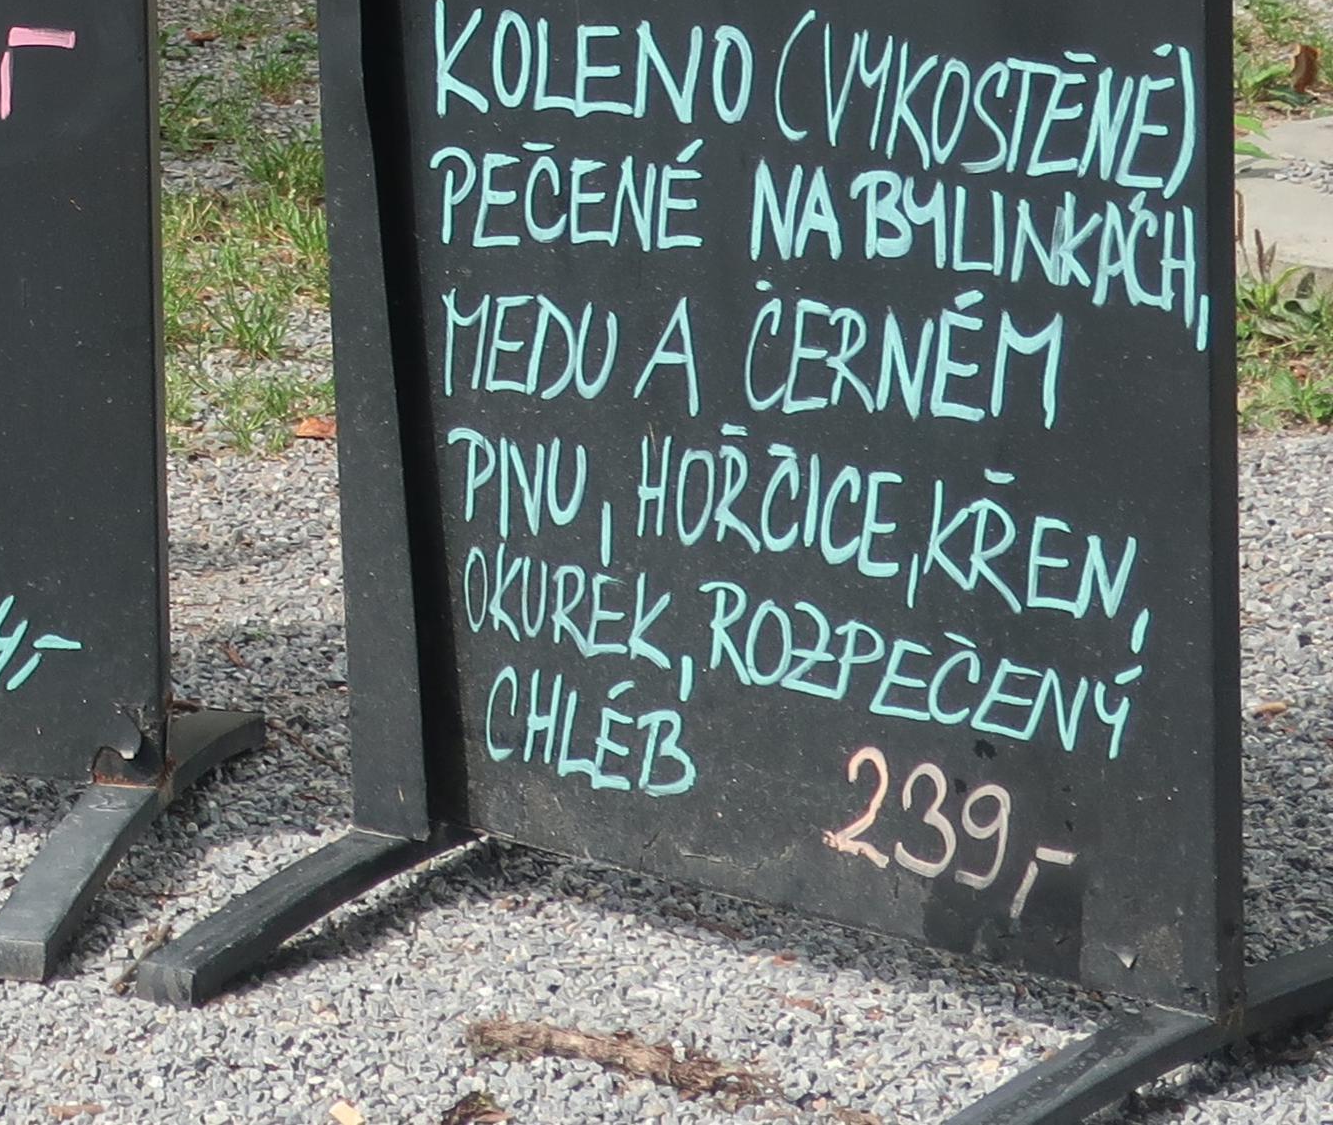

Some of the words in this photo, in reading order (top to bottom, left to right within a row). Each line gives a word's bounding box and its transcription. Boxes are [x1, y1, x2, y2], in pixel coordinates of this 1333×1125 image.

[430, 139, 704, 249] PEČENÉ
[751, 159, 841, 262] NA
[443, 289, 618, 400] MEDU
[634, 296, 699, 416] A
[744, 279, 1063, 429] ČERNÉM
[485, 666, 696, 796] CHLÉB
[700, 582, 1141, 759] ROZPEČENÝ
